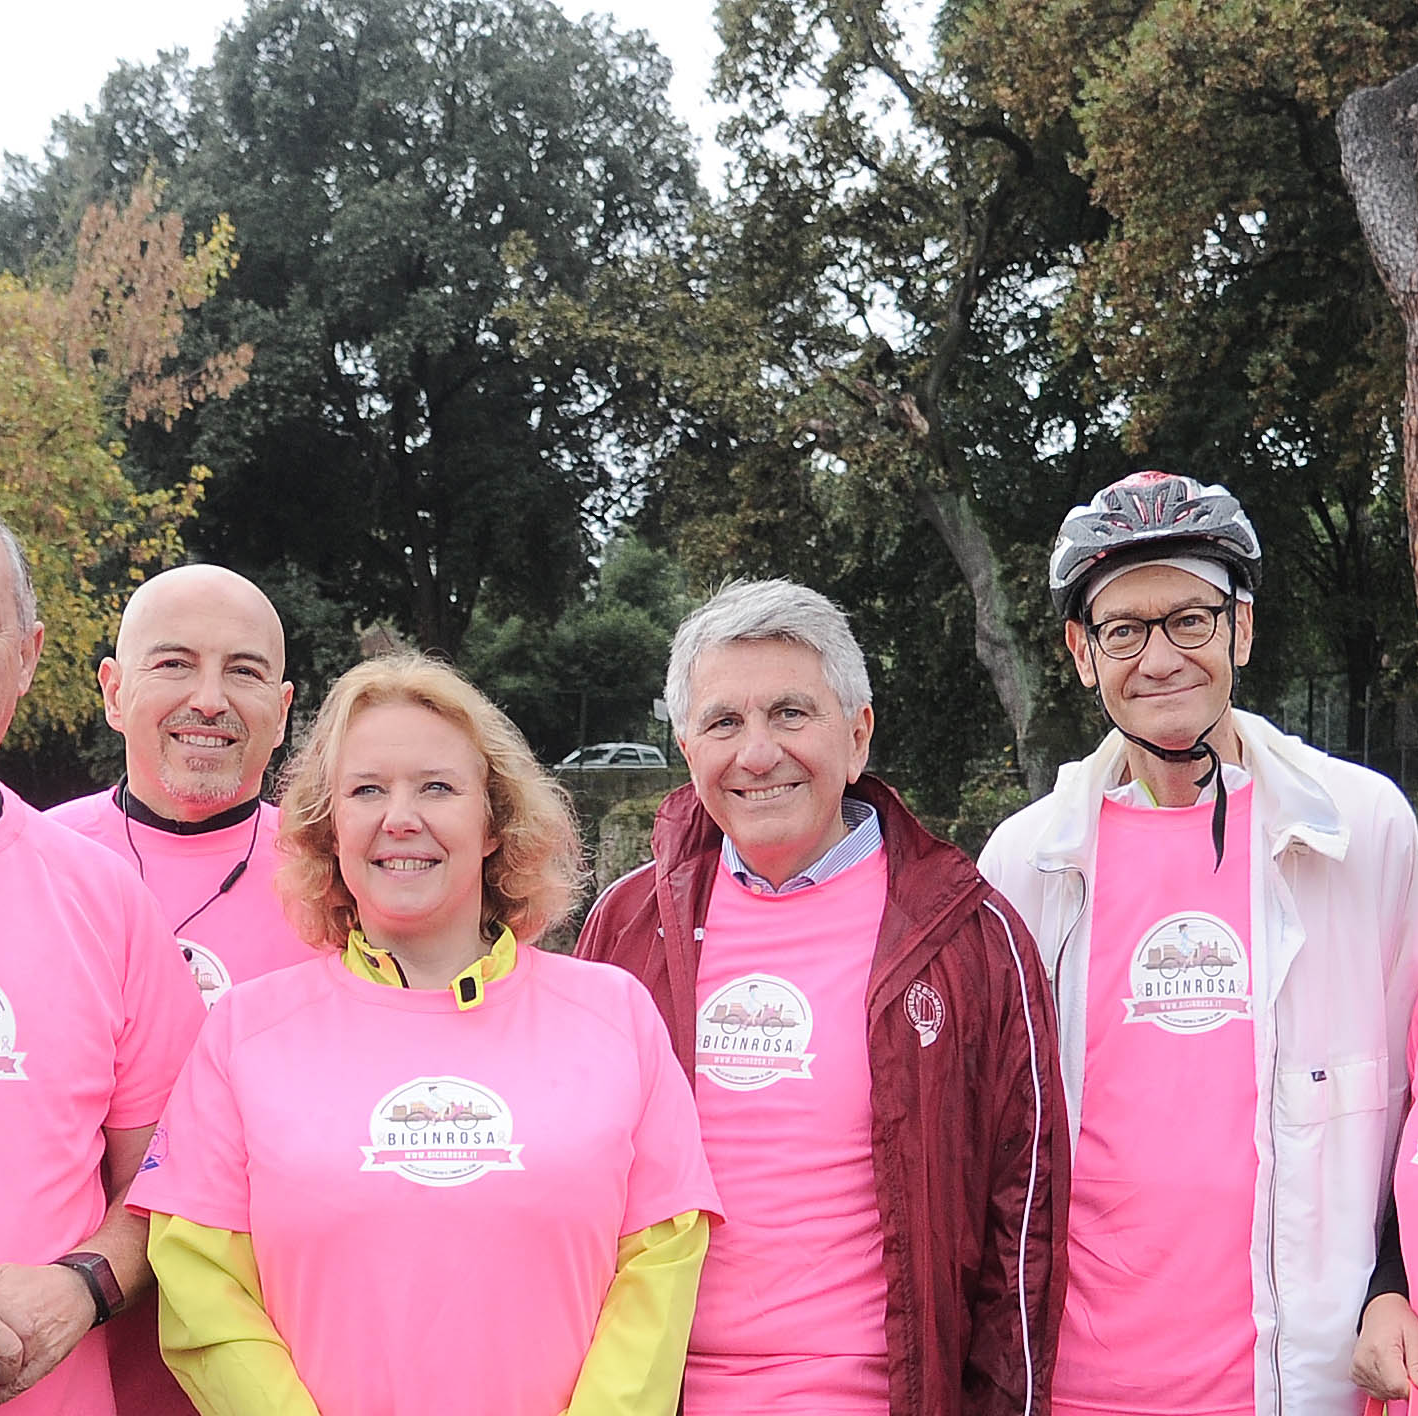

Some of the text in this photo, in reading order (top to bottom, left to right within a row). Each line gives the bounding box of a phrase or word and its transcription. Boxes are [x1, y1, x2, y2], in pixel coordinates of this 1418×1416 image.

[1145, 979, 1236, 997] BICINROSA
[703, 1035, 792, 1052] BICINROSA
[387, 1131, 495, 1146] BICINROSA
